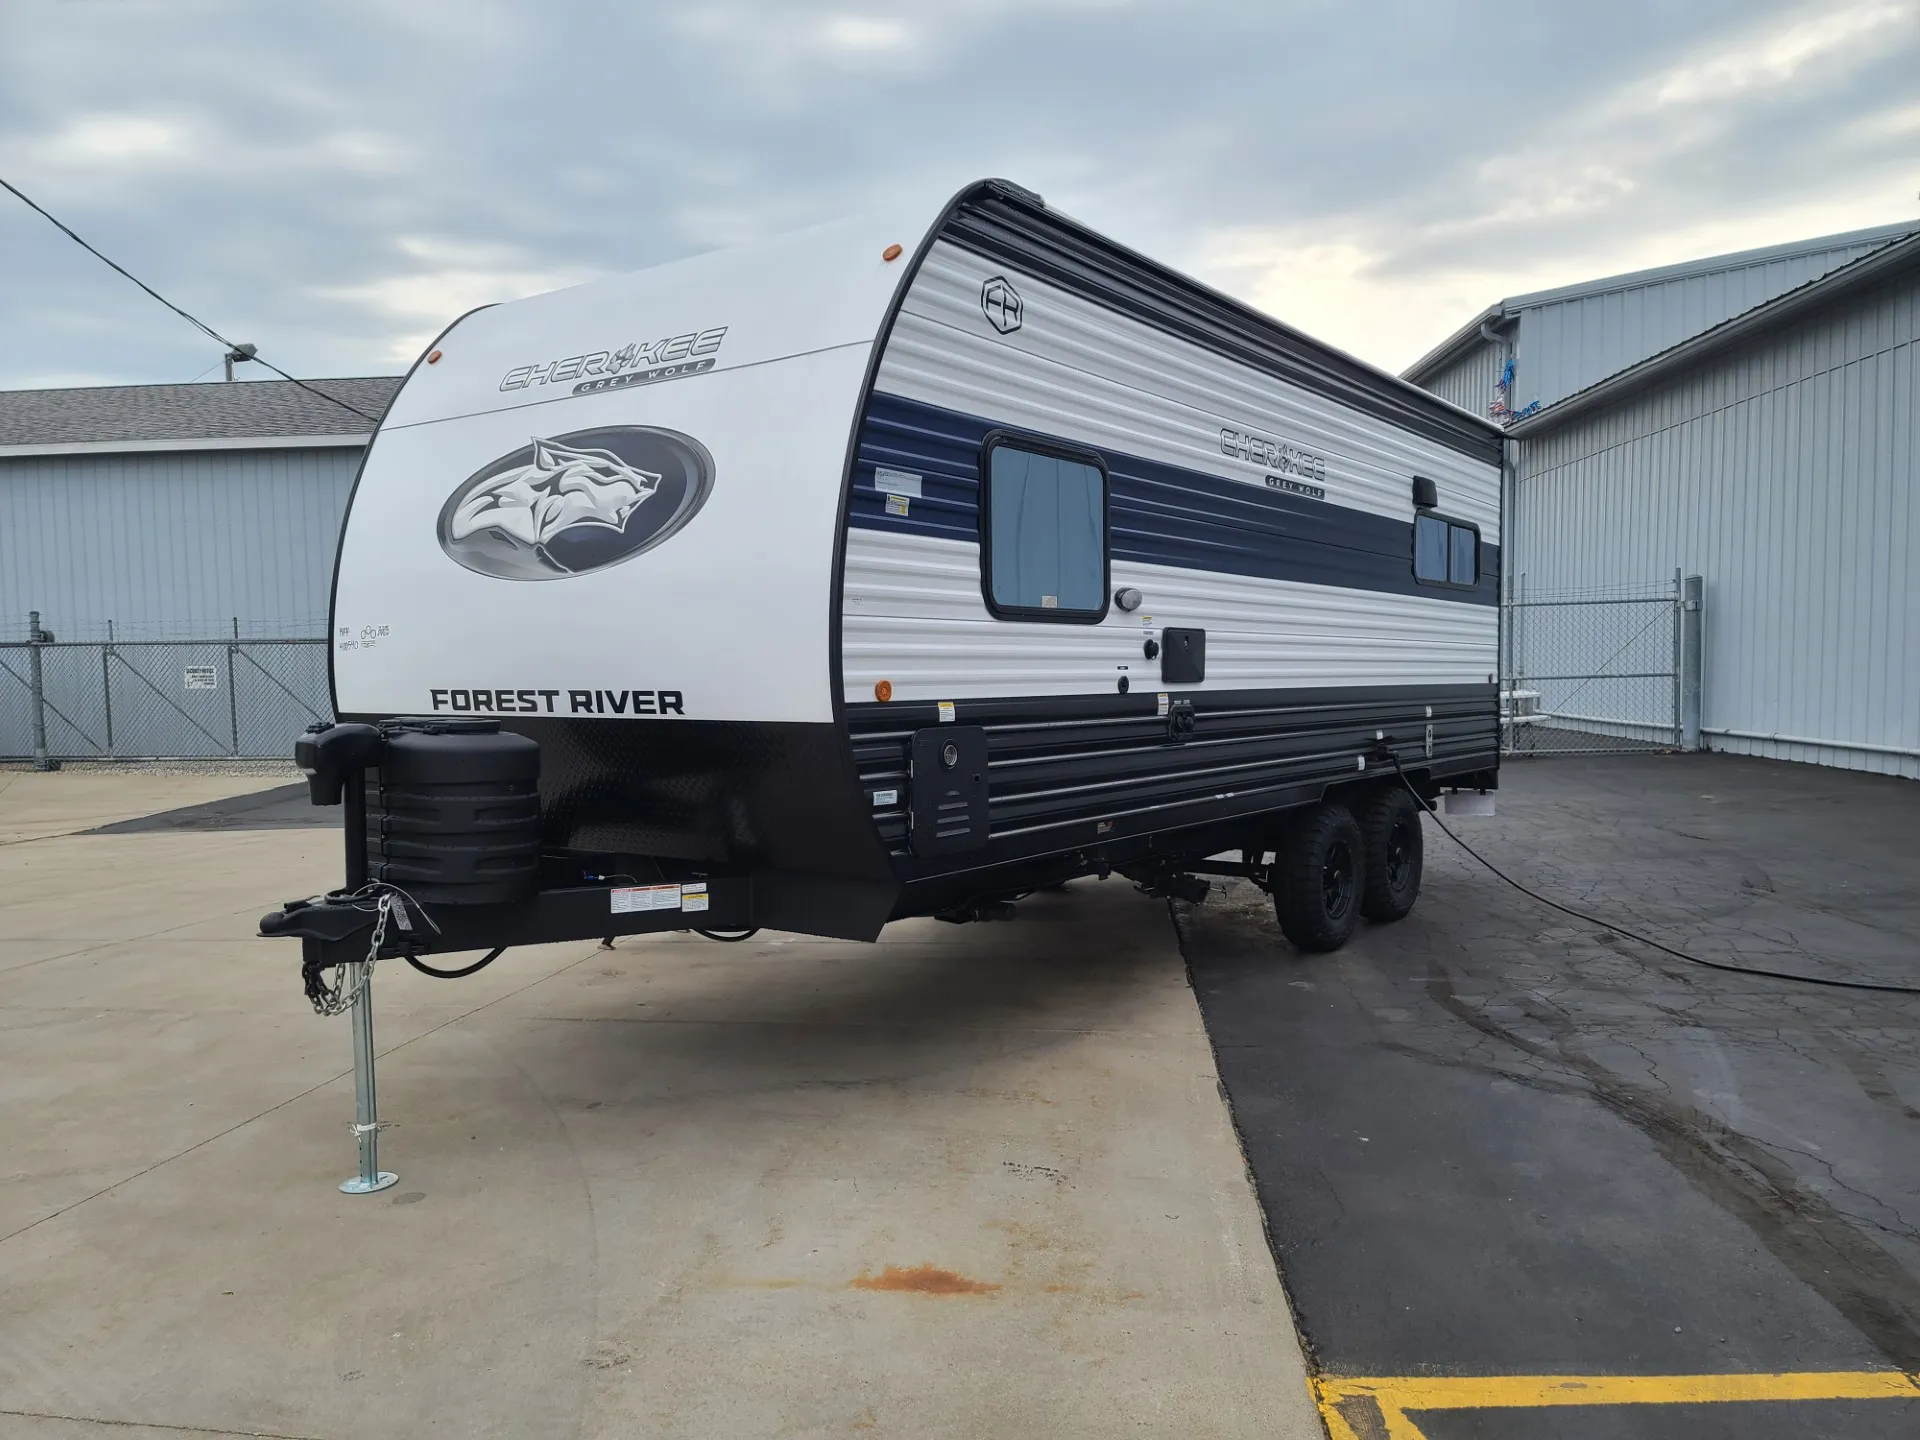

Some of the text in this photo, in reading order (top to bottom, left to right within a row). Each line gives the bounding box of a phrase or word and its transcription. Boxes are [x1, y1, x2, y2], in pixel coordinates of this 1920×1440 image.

[581, 361, 706, 392] GREY WOLF
[1269, 477, 1322, 497] GREY WOLF
[429, 689, 686, 715] FOREST RIVER
